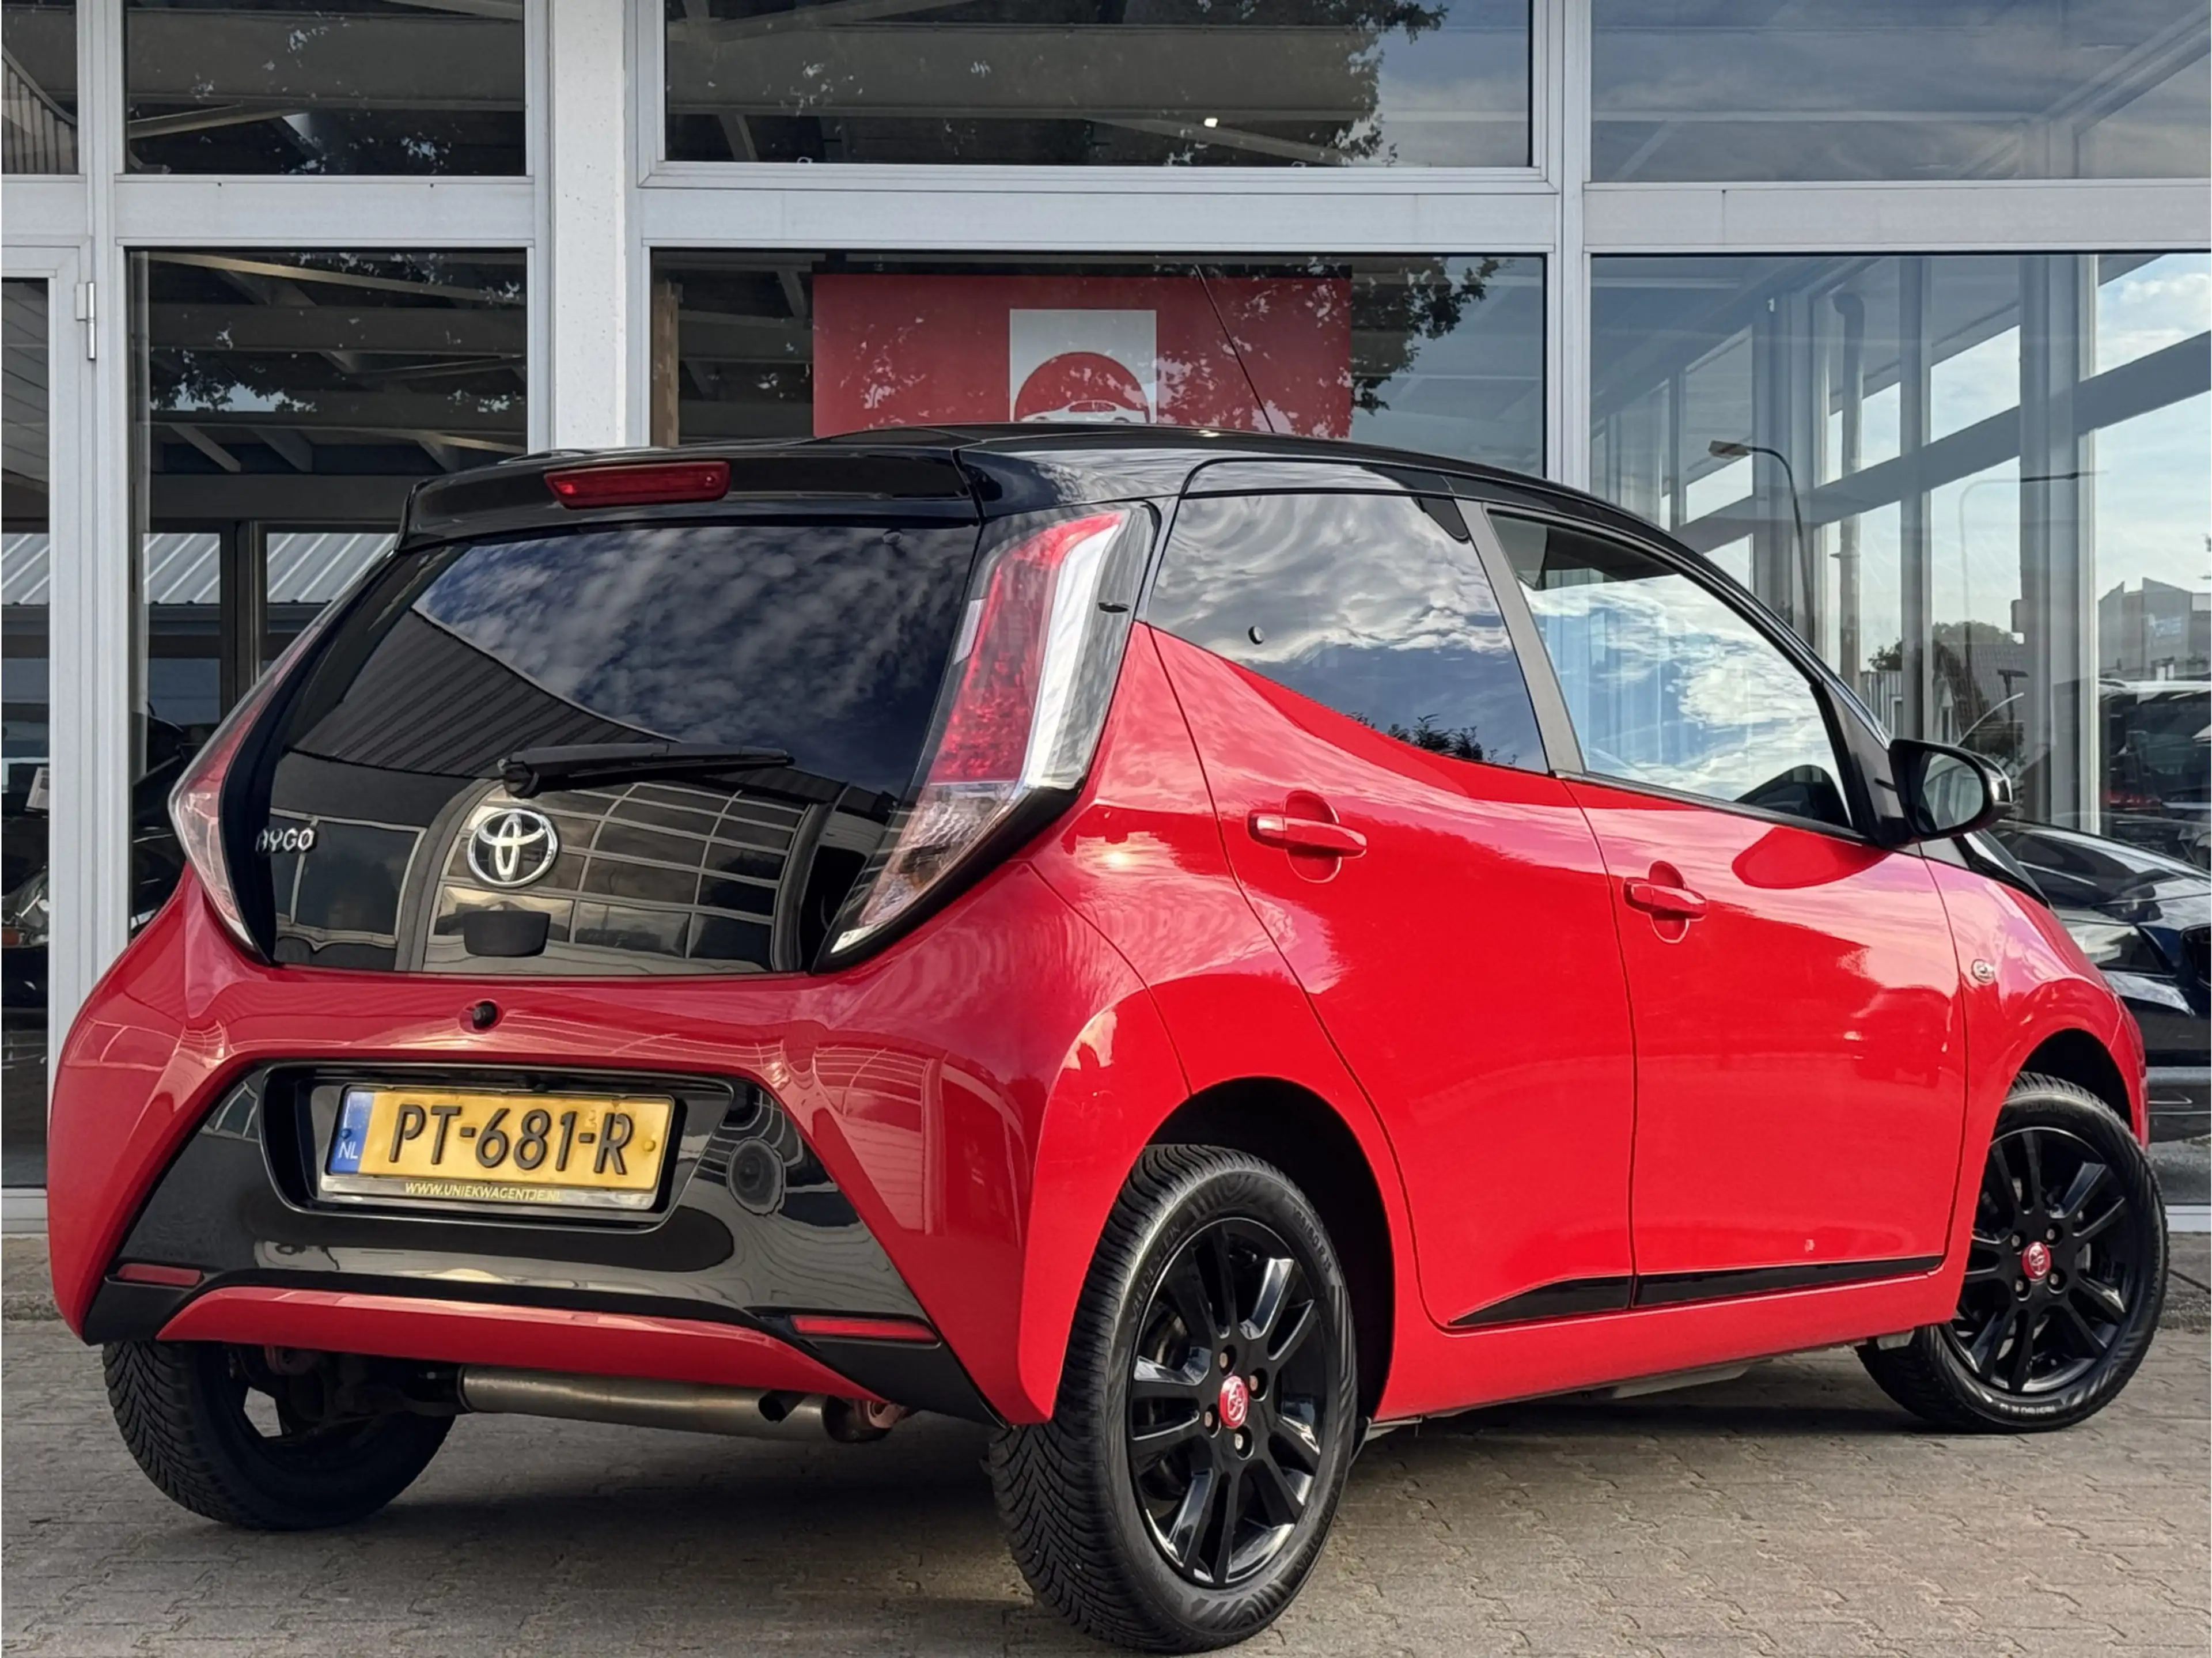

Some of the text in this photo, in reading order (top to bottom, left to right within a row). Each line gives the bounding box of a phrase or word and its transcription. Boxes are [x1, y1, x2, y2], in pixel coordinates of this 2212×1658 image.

[255, 827, 315, 852] AYGO
[388, 1103, 632, 1175] PT-681-R
[338, 1141, 358, 1160] NL
[405, 1182, 562, 1202] WWW.UNIEKWAGENTJE.NL
